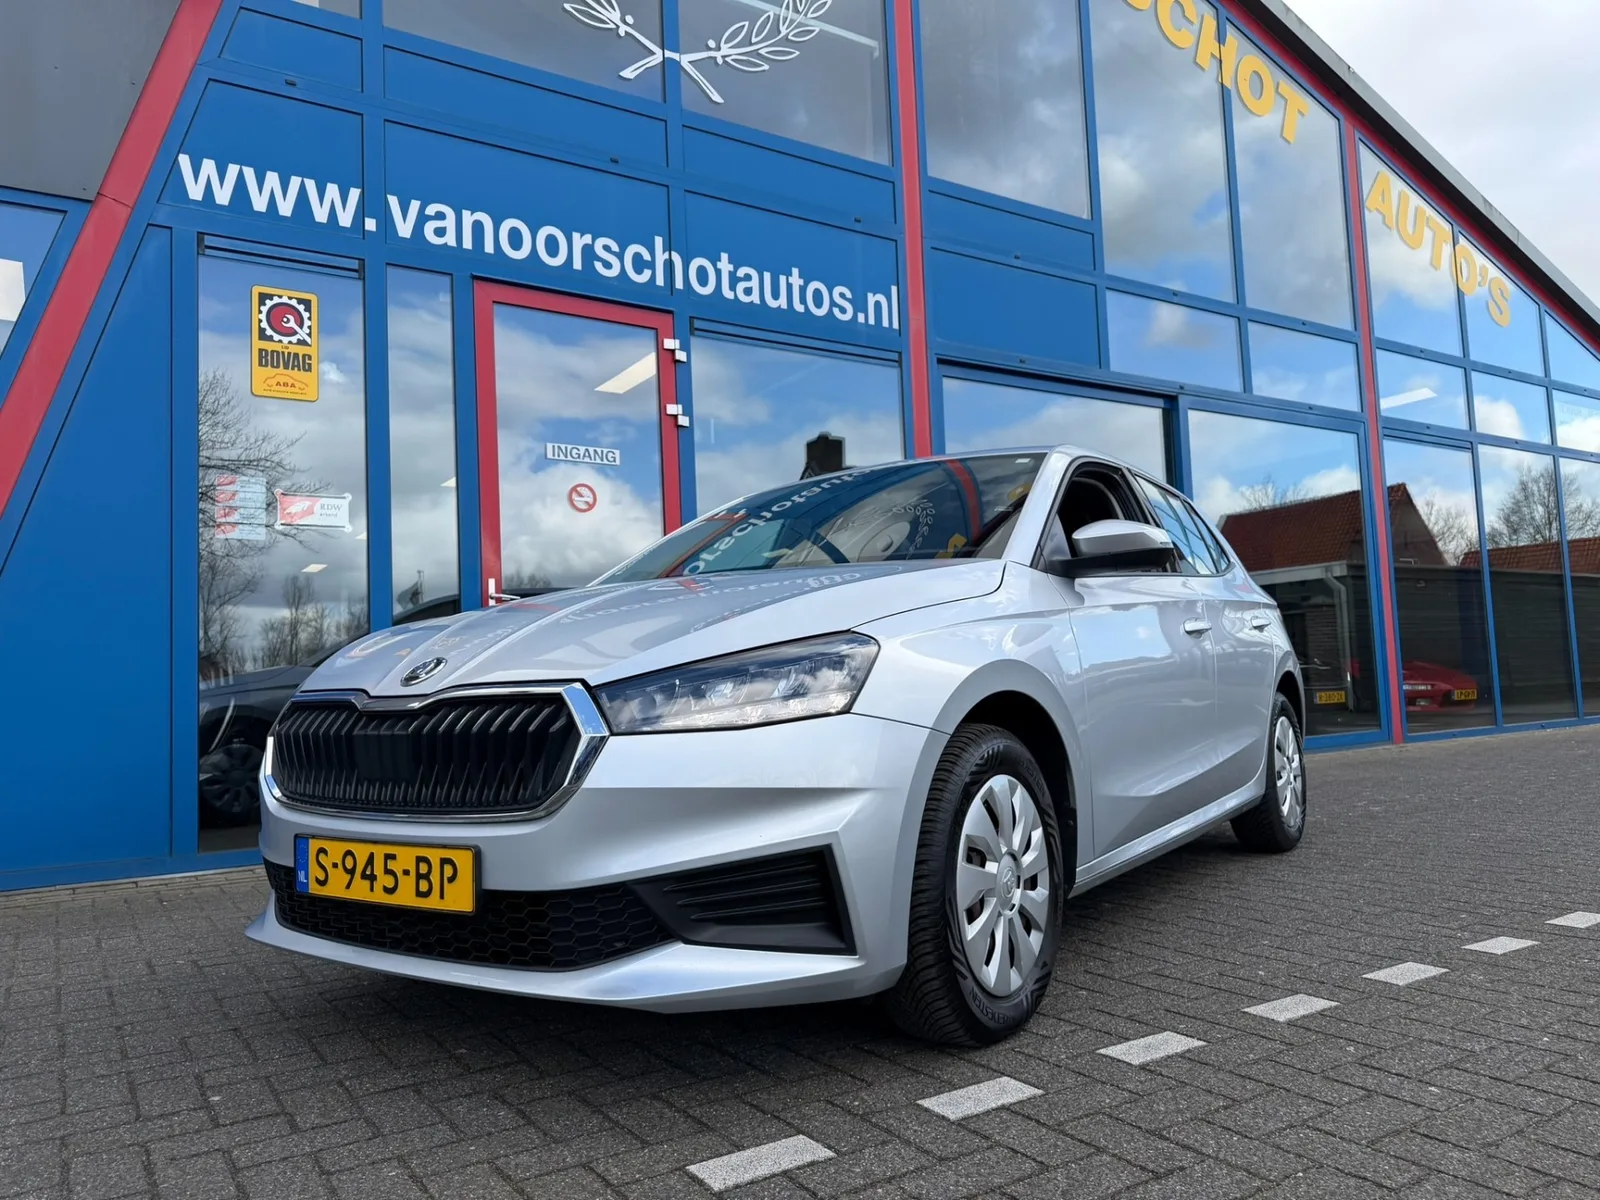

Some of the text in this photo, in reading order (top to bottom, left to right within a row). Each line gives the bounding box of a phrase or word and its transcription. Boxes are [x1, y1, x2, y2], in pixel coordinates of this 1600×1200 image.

[1124, 0, 1511, 327] CHOT AUTO'S
[178, 153, 899, 330] www.vanoorschotautos.nl
[258, 348, 312, 373] BOVAG
[552, 444, 616, 463] INGANG
[320, 503, 342, 511] RDW
[297, 870, 308, 883] NL
[315, 847, 458, 899] S-945-BP
